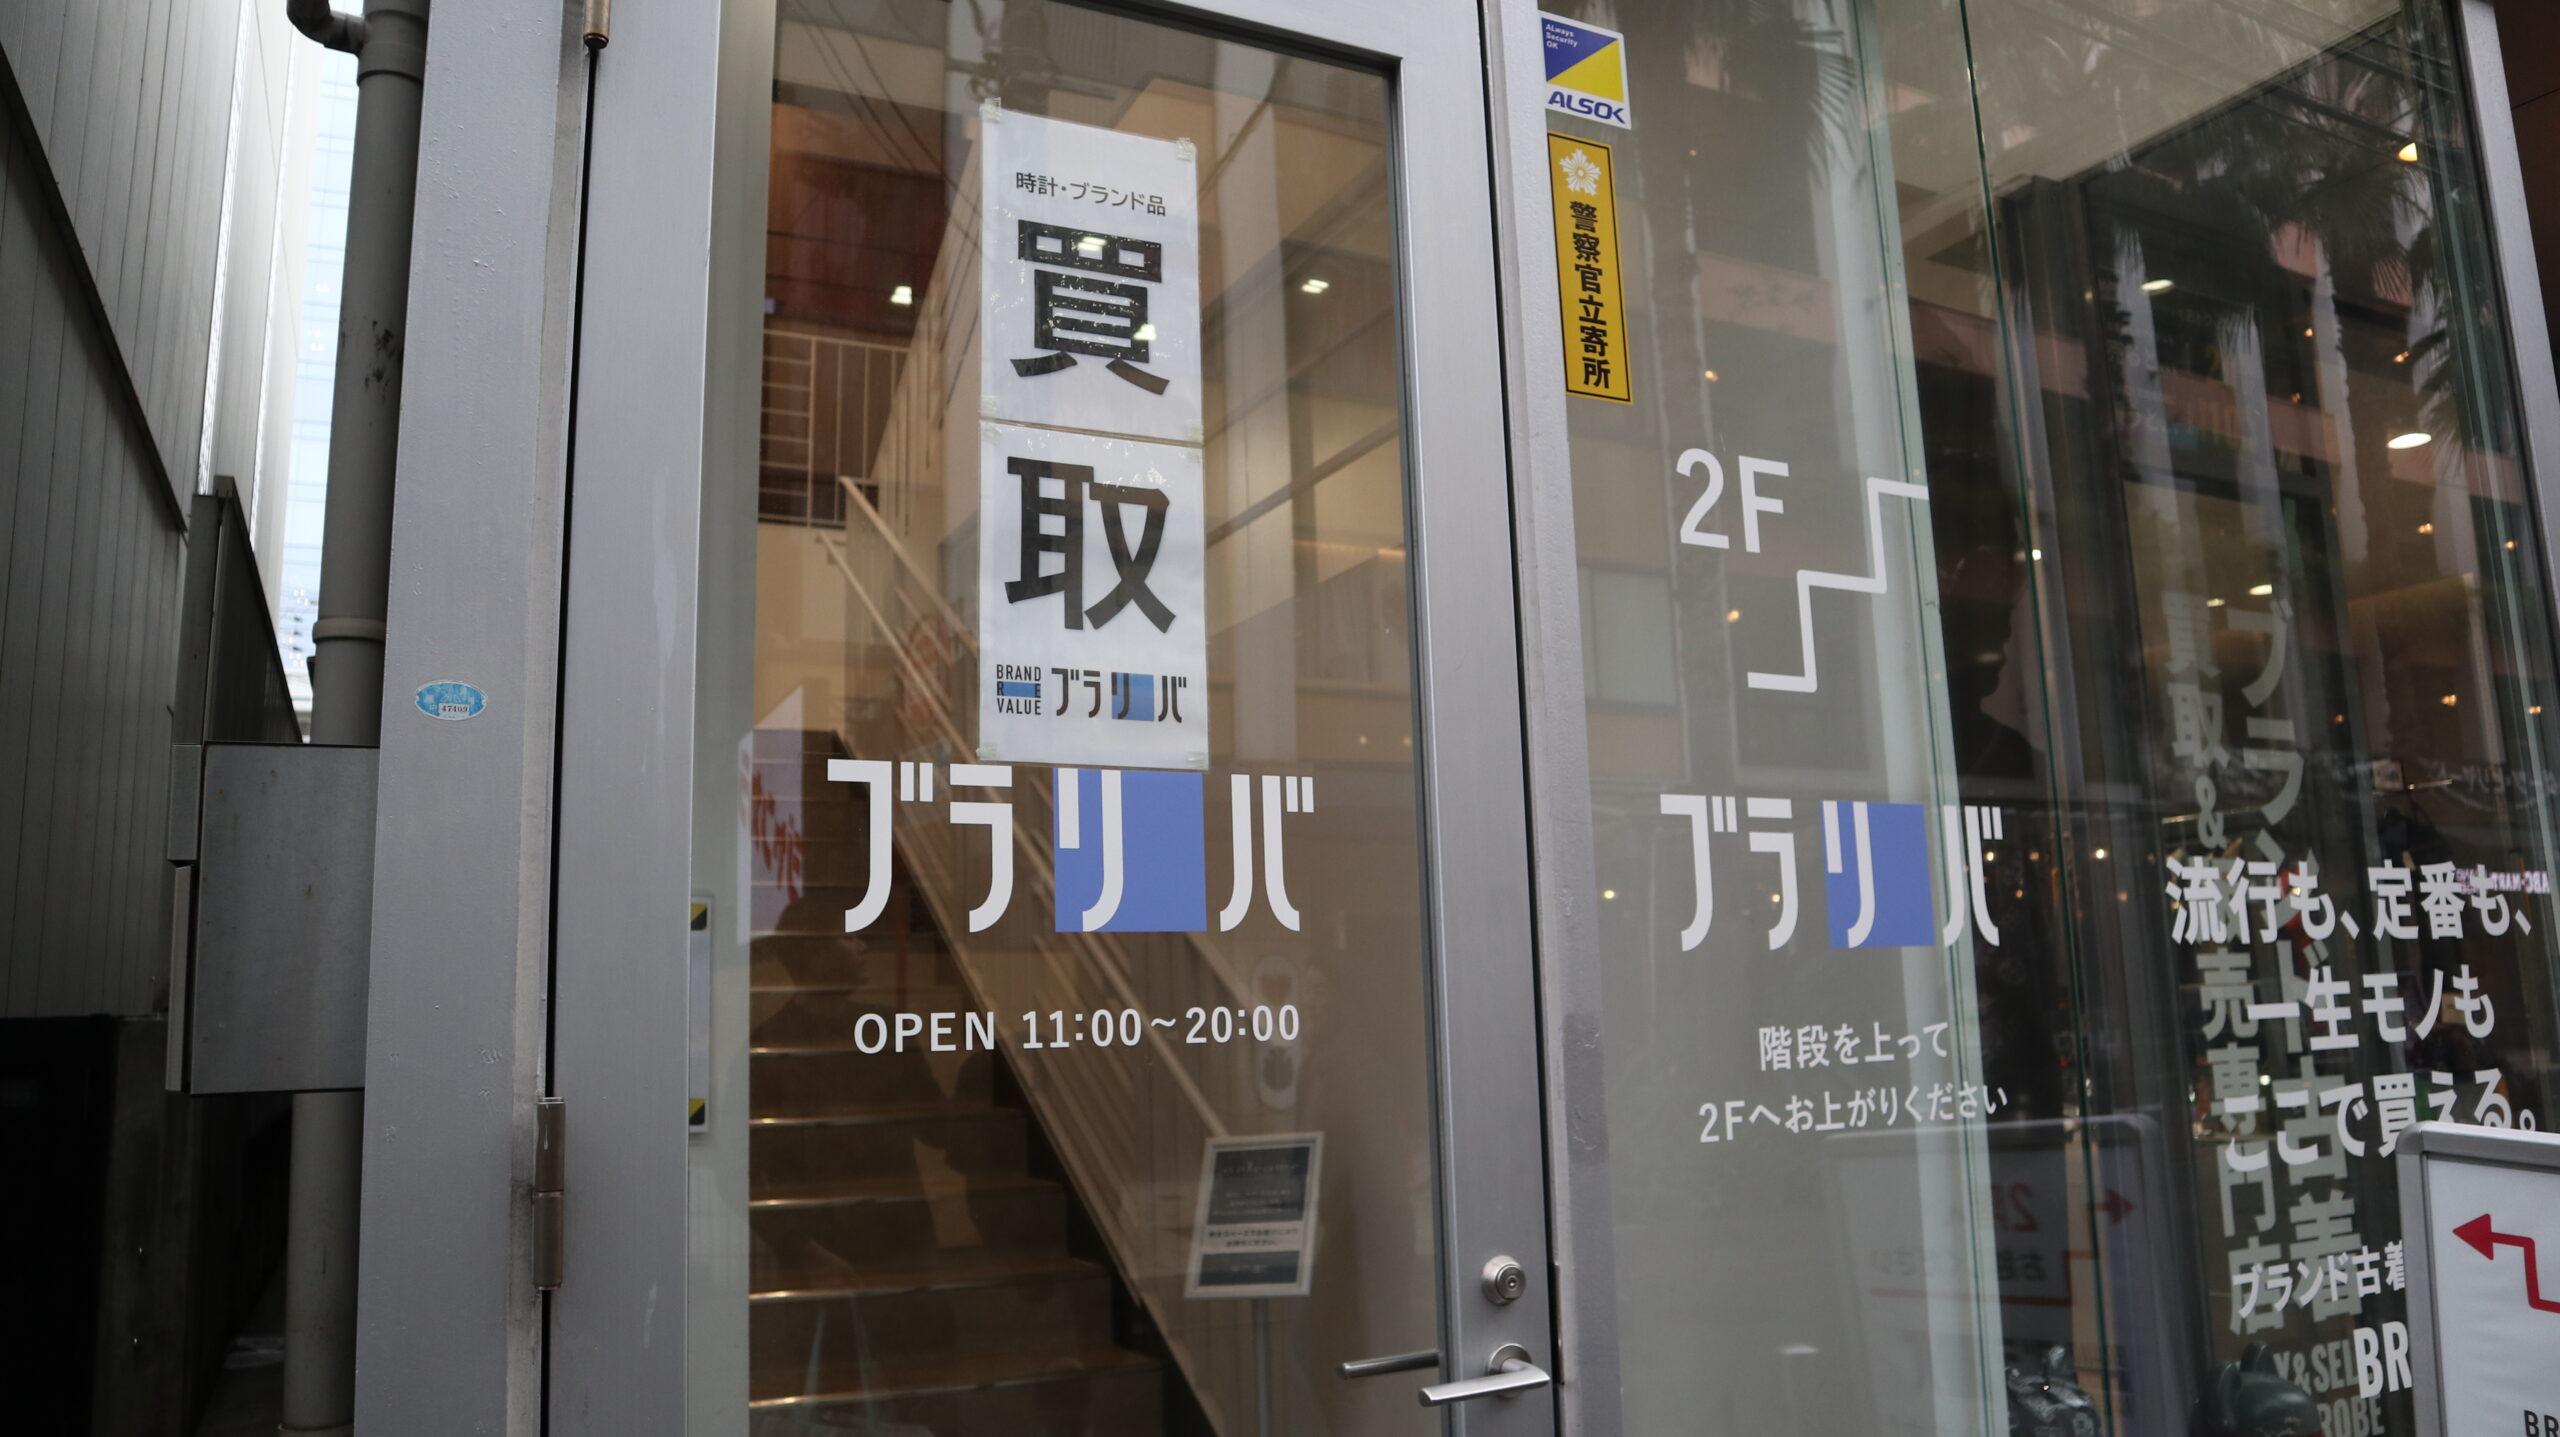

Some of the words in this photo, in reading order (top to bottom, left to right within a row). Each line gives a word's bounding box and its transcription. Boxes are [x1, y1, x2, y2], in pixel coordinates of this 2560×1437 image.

[1545, 32, 1578, 48] Security
[1546, 41, 1558, 49] OK
[1548, 90, 1626, 124] ALSOK
[1015, 171, 1167, 217] 時計・ブランド品
[1569, 200, 1611, 389] 警察官立寄所
[1676, 447, 1790, 553] 2F
[996, 663, 1042, 682] BRAND
[1051, 667, 1187, 723] ブラリバ
[997, 698, 1042, 716] VALUE
[826, 758, 1315, 933] ブラリバ
[1660, 793, 2004, 952] ブラリバ
[2165, 855, 2532, 945] 流行も、定番も、
[854, 1011, 996, 1054] OPEN
[2247, 964, 2495, 1051] 一生モノも
[1758, 1021, 1950, 1072] 階段を上って
[1698, 1081, 2008, 1143] 2Fへお上がりください
